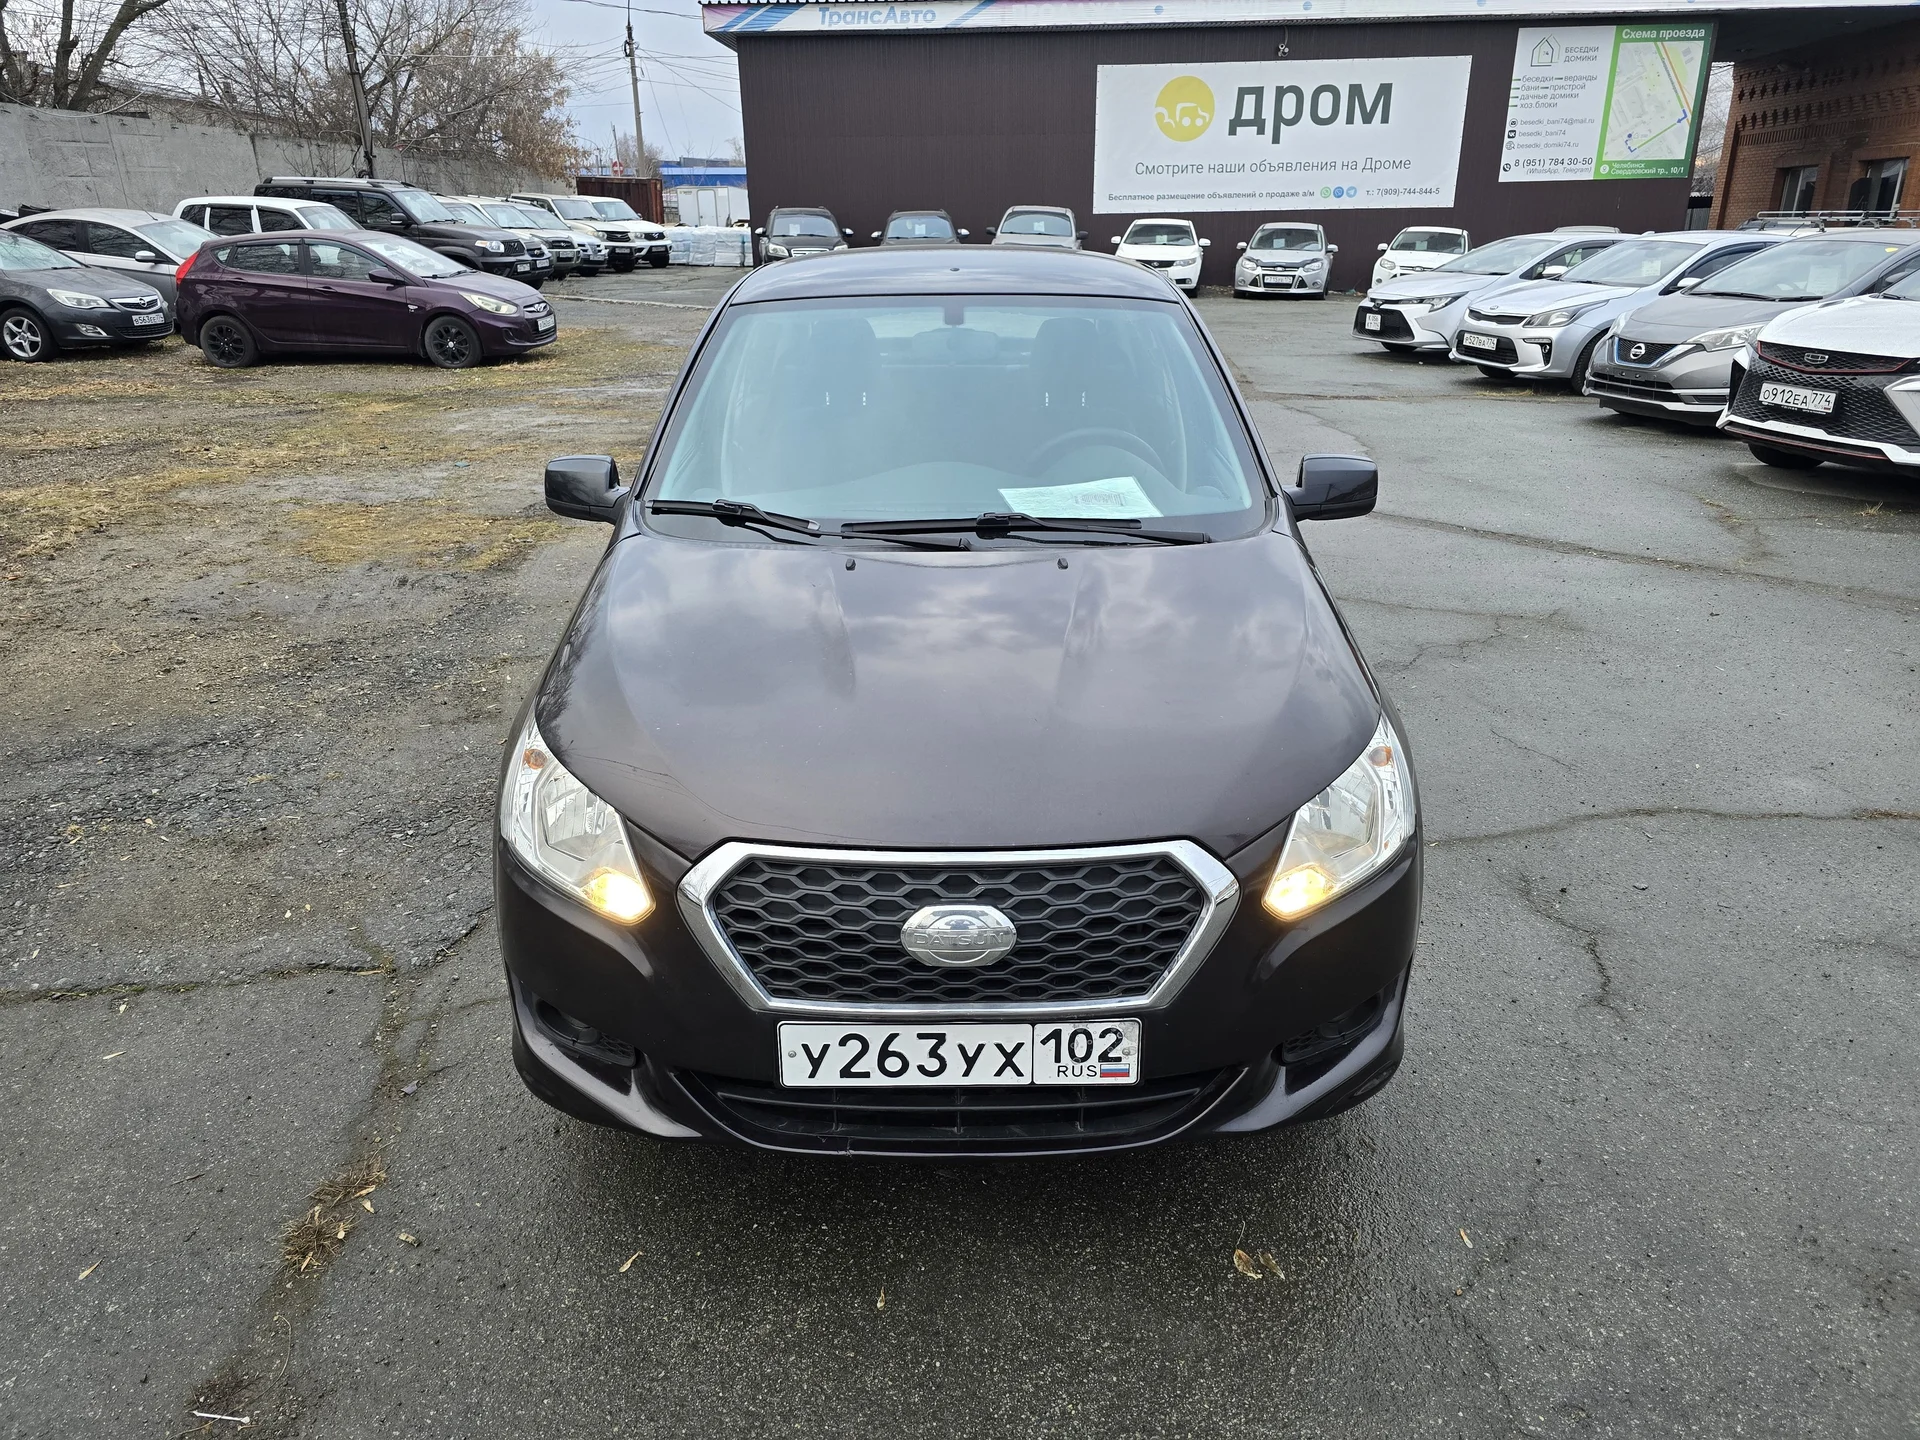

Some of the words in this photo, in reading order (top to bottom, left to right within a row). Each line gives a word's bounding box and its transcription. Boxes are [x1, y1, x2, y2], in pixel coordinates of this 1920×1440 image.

[818, 6, 937, 27] ТрансАвто
[1622, 29, 1657, 39] Схема
[1660, 28, 1705, 39] проезда
[1564, 46, 1599, 54] БЕСЕДКИ
[1563, 55, 1598, 63] ДОМИКИ
[1522, 75, 1554, 83] беседки
[1563, 74, 1598, 82] веранды
[1520, 83, 1540, 91] бани
[1549, 82, 1586, 92] пристрой
[1549, 92, 1579, 100] домики
[1227, 82, 1393, 145] дром
[1134, 161, 1204, 177] Смотрите
[1207, 162, 1246, 174] наши
[1249, 159, 1337, 173] объявления
[1341, 160, 1358, 171] на
[1361, 157, 1412, 173] Дроме
[1514, 158, 1520, 167] 8
[1522, 158, 1546, 168] (951)
[1549, 157, 1565, 166] 784
[1566, 157, 1593, 166] 30-50
[1670, 166, 1684, 174] 10/1
[1108, 193, 1155, 201] Бесплатное
[1156, 193, 1206, 201] размещение
[1207, 190, 1256, 199] объявлений
[1265, 191, 1300, 199] продаже
[1376, 187, 1440, 197] 7(909)-744-844-5
[1763, 387, 1808, 407] О912ЕА
[1811, 392, 1831, 406] 774
[914, 932, 1004, 945] DATSUN
[801, 1032, 1025, 1079] У263УХ
[1039, 1028, 1124, 1064] 102
[1056, 1064, 1098, 1078] RUS
